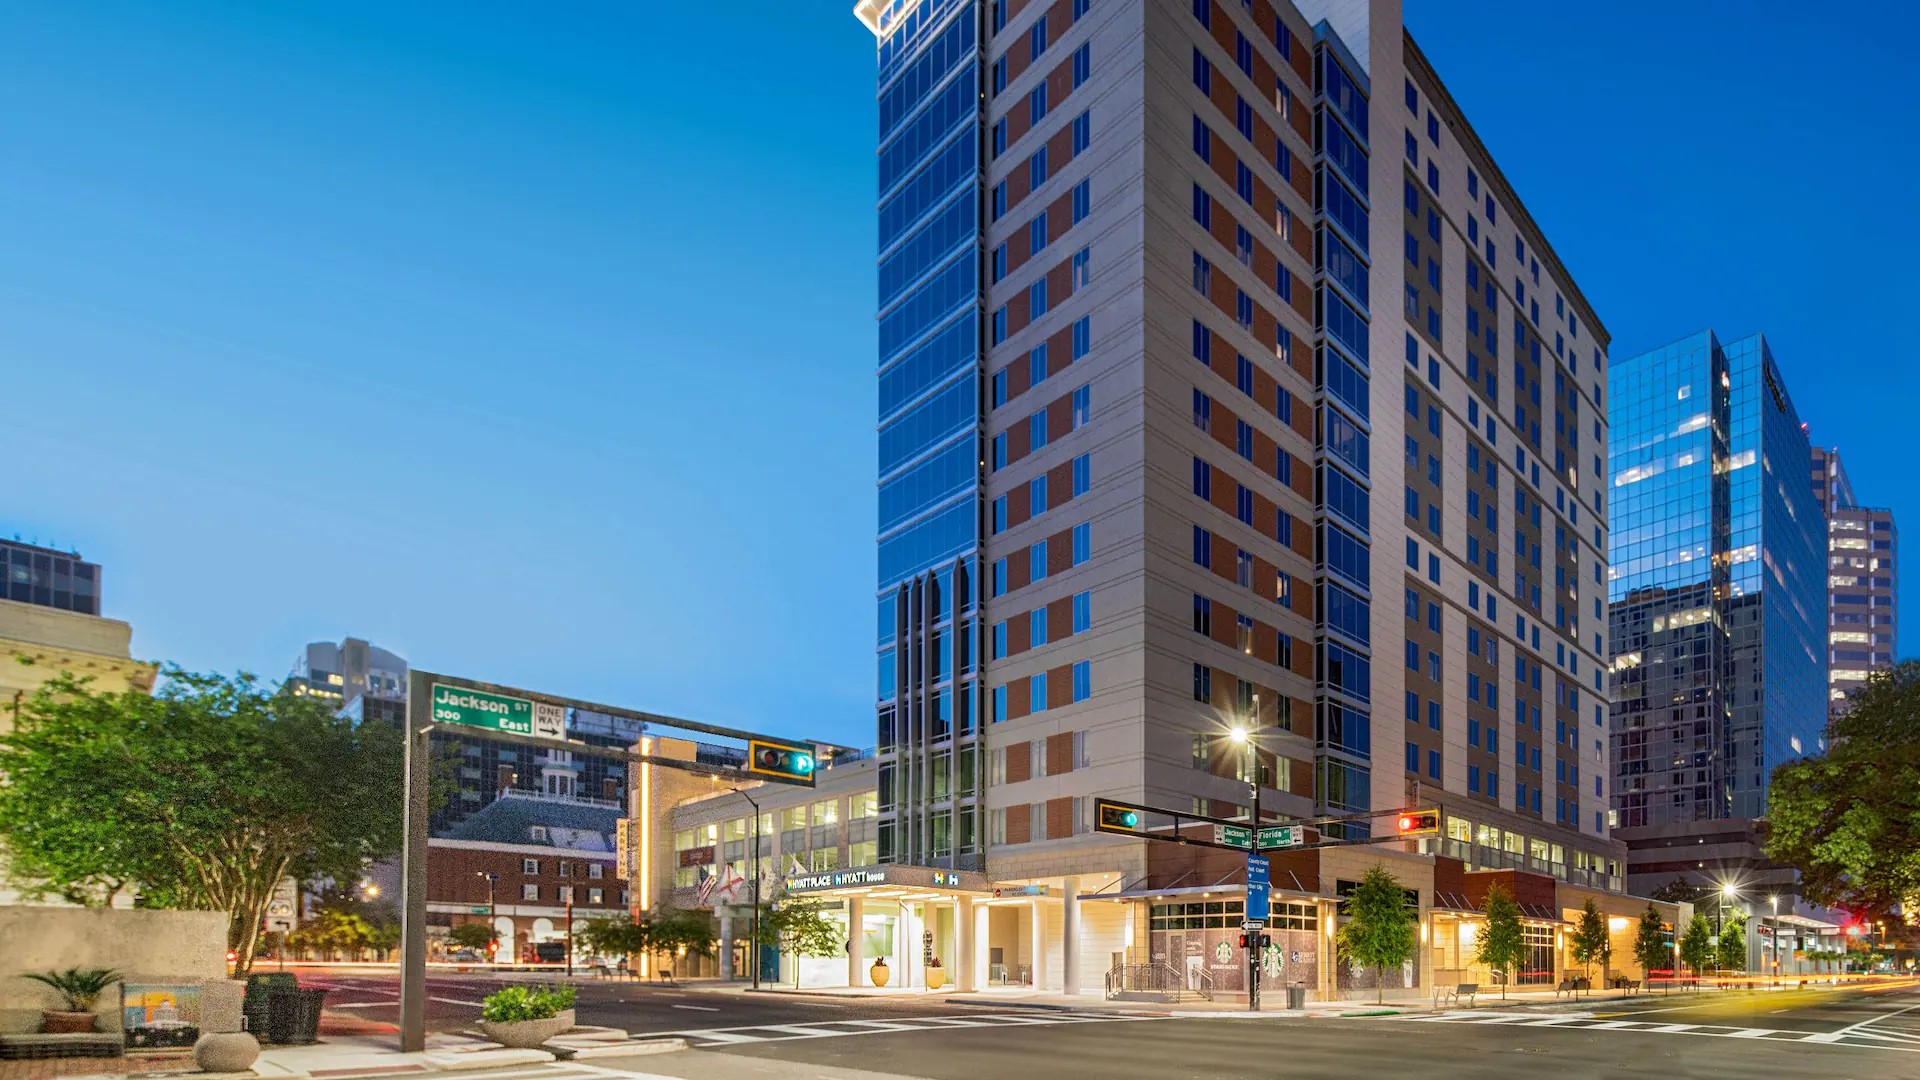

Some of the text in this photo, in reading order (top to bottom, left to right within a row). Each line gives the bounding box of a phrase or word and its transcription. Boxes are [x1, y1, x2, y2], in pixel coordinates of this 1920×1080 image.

[436, 690, 529, 714] Jackson ST
[538, 706, 561, 718] ONE
[436, 708, 529, 732] 300 East
[538, 715, 561, 726] WAY
[1225, 828, 1246, 838] Jackson
[1259, 830, 1282, 840] Florida
[1276, 838, 1291, 846] North
[811, 875, 831, 888] PLACE
[842, 872, 866, 885] HYATT
